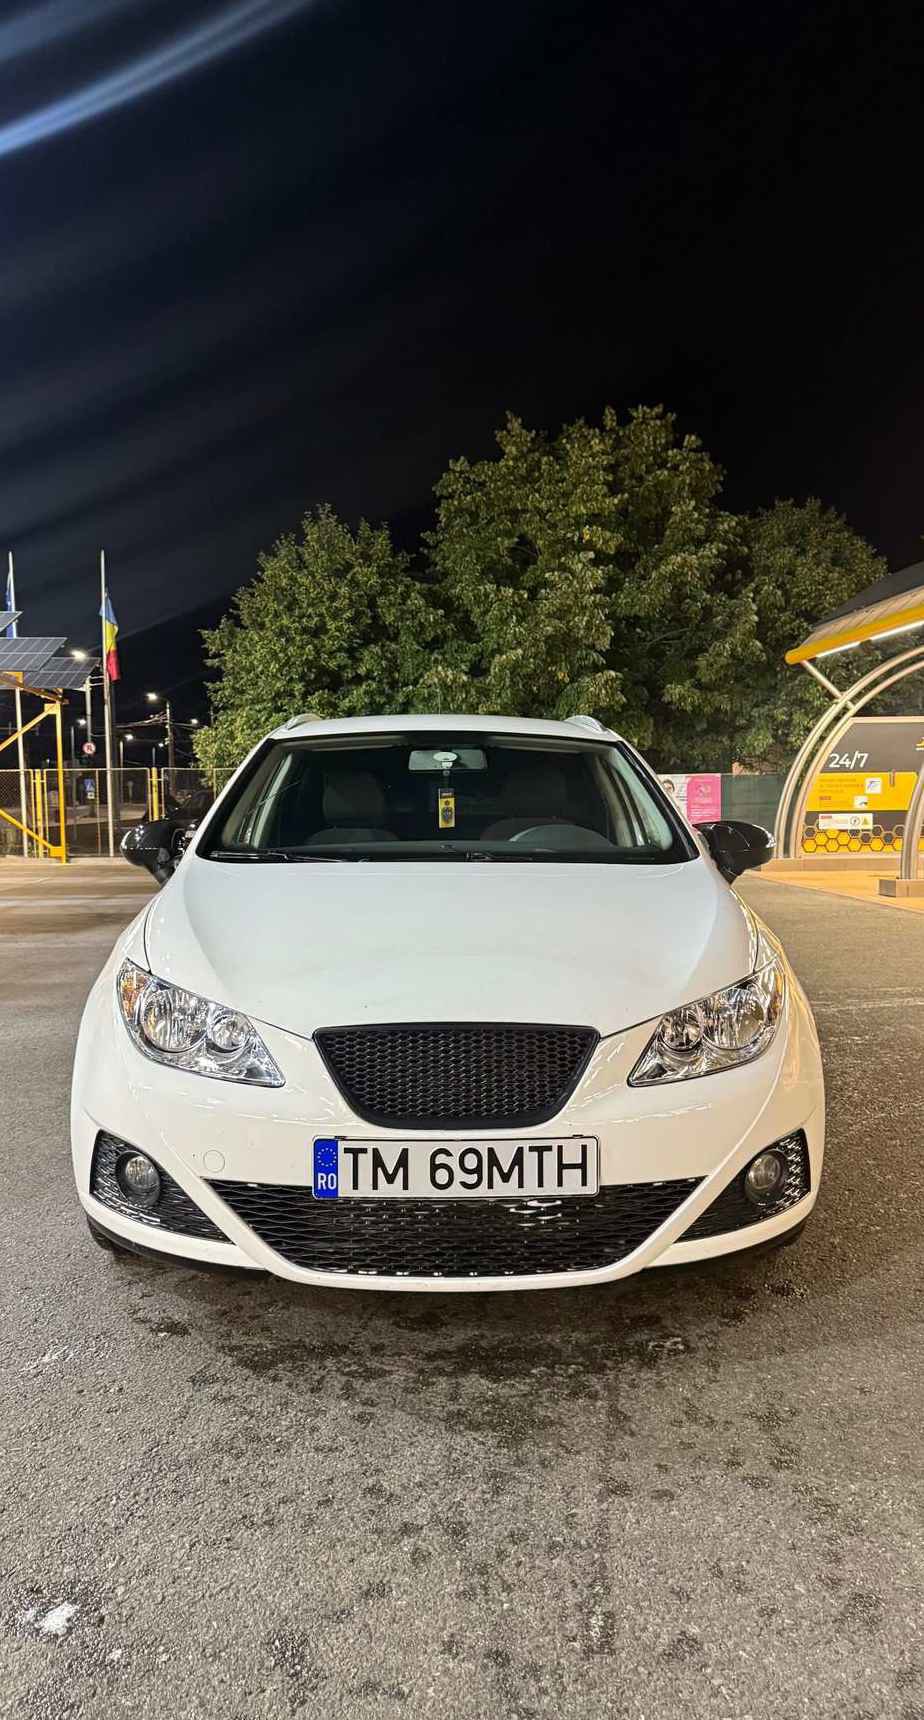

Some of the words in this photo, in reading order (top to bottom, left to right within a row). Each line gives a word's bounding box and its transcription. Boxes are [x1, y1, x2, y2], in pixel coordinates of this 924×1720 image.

[829, 750, 869, 769] 24/7
[343, 1147, 409, 1190] TM
[317, 1173, 337, 1190] RO
